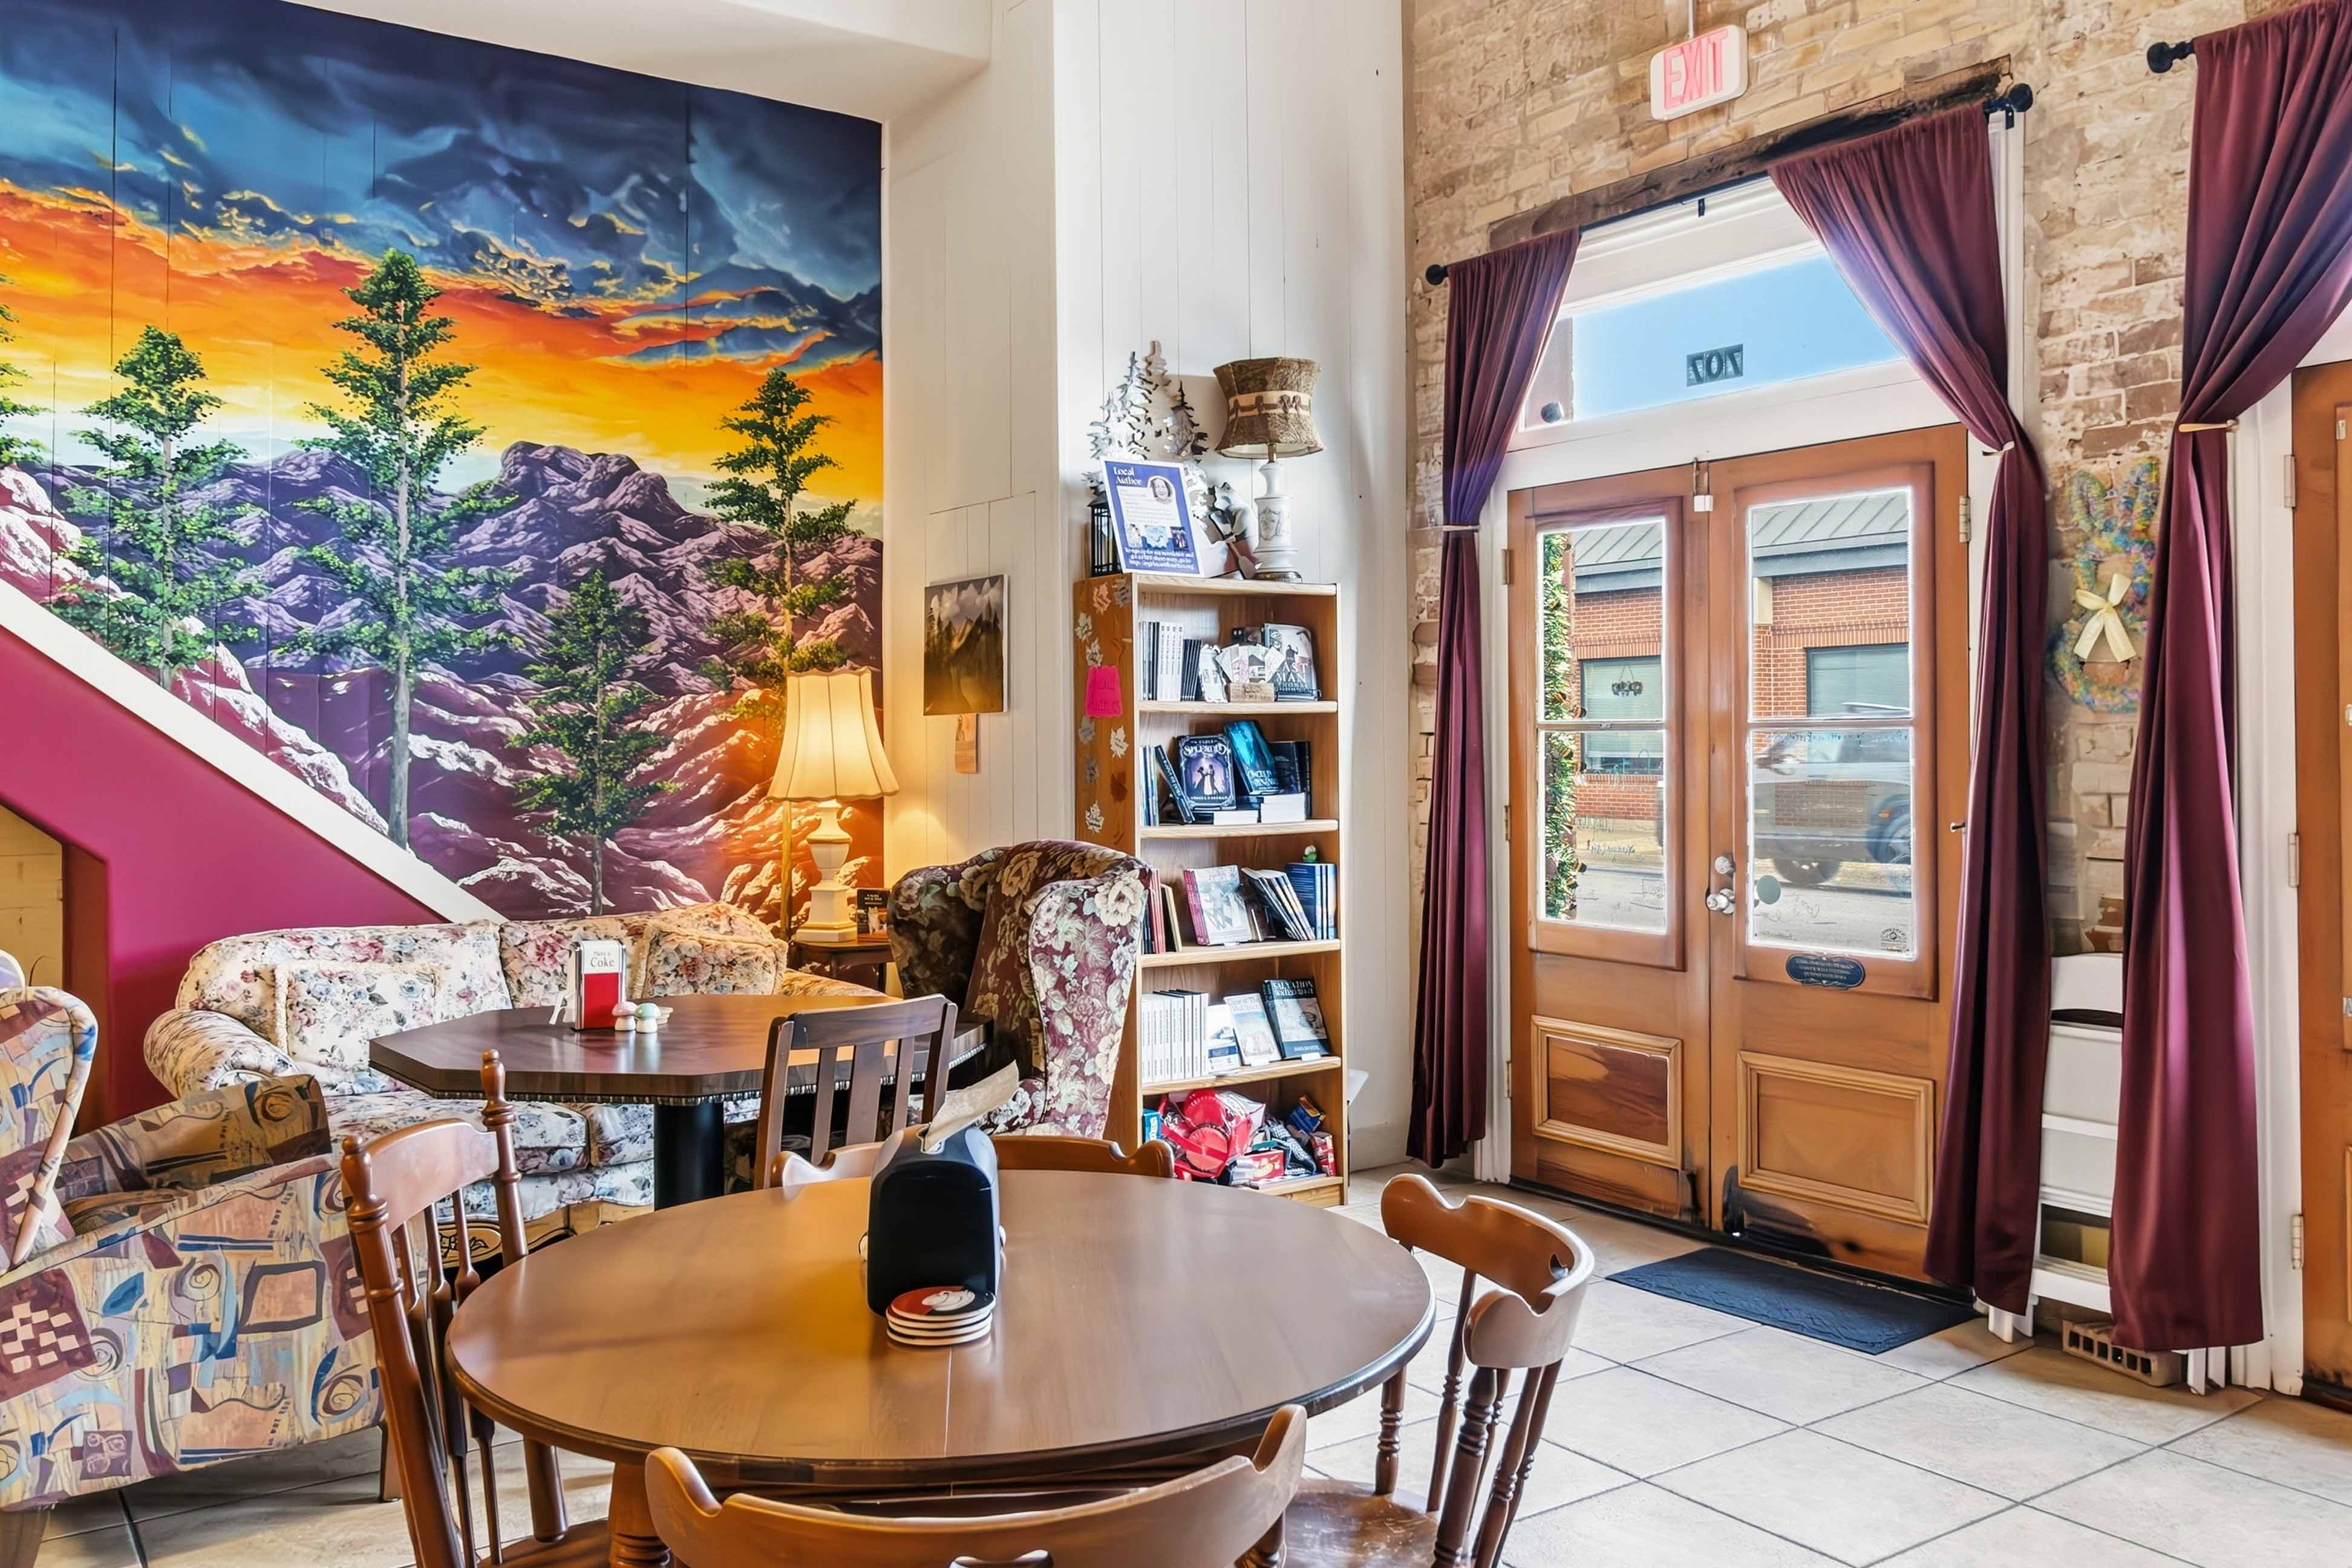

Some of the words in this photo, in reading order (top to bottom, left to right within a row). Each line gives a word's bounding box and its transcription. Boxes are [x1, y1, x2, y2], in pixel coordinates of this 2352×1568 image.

[1664, 28, 1728, 110] EXIT
[1113, 466, 1135, 476] Local
[1116, 475, 1143, 485] Author
[1276, 672, 1307, 682] MAN
[590, 957, 615, 967] Coke
